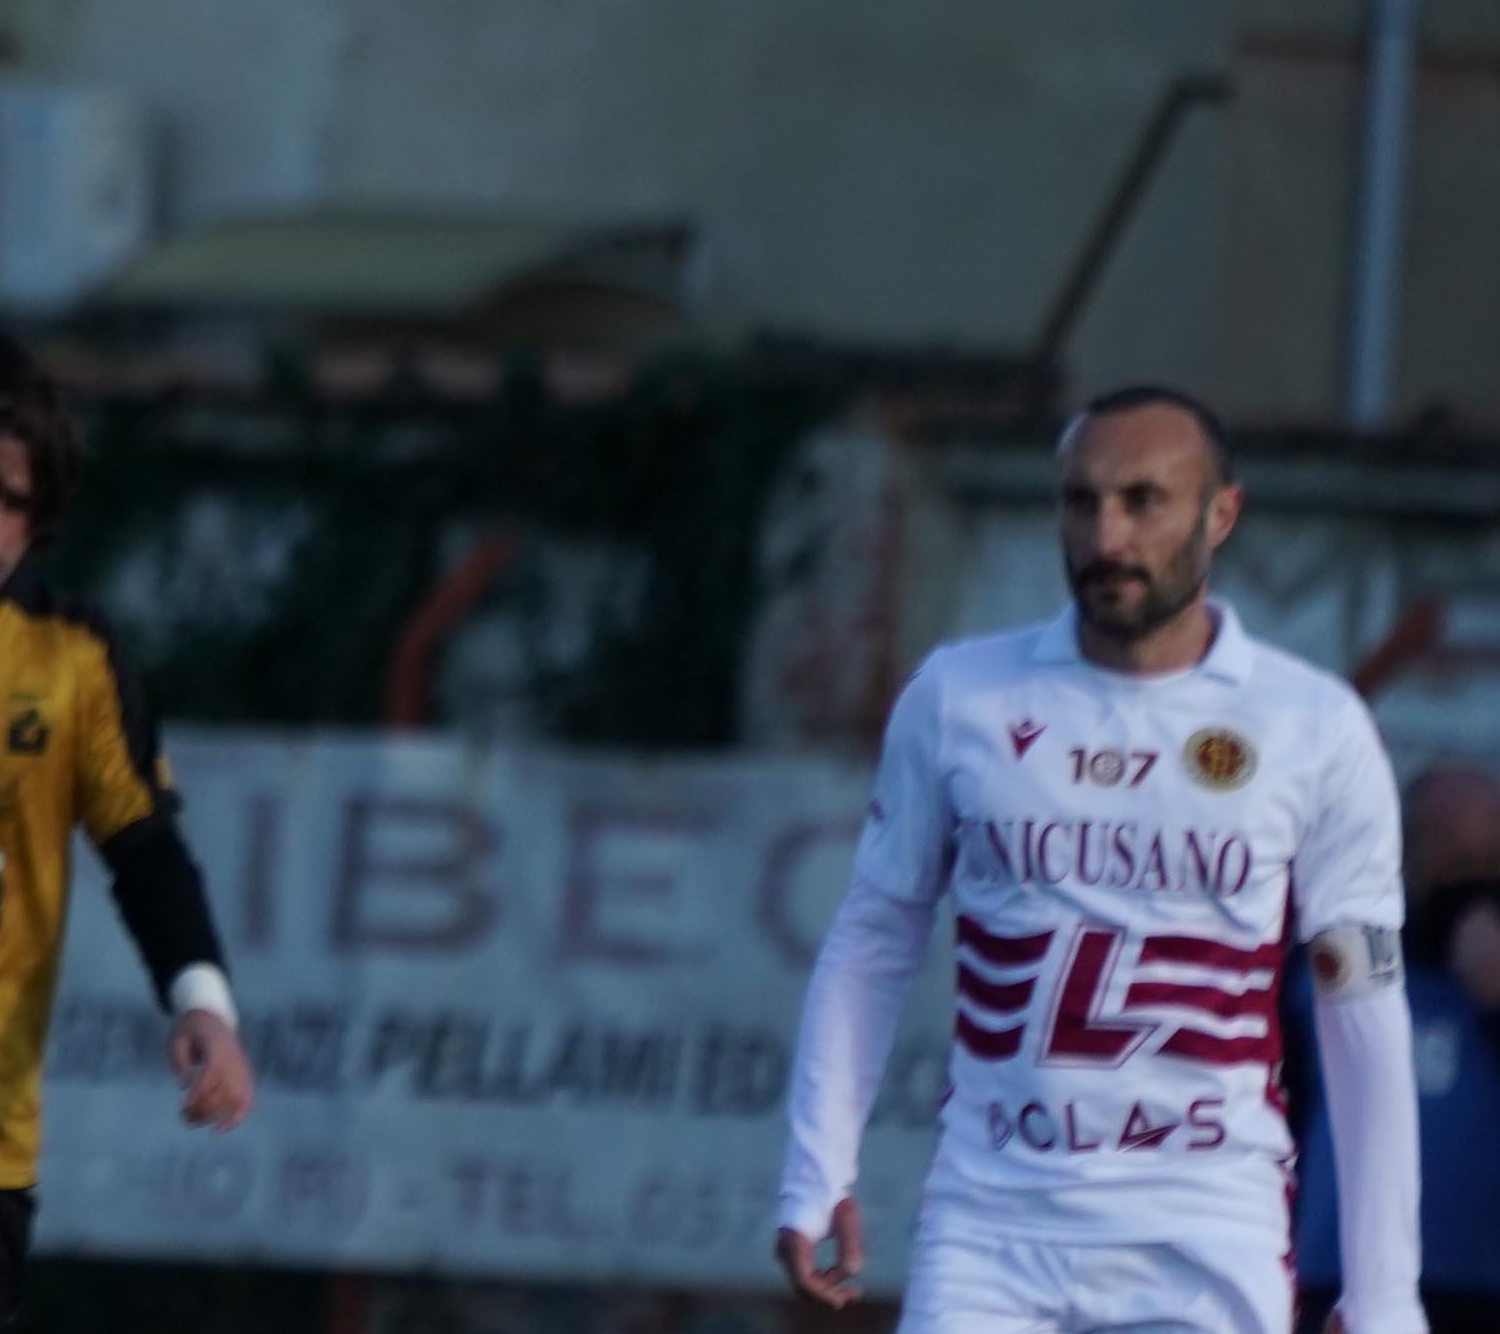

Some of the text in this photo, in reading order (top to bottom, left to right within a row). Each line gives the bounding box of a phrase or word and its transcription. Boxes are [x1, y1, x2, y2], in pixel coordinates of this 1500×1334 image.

[1067, 746, 1158, 788] 107
[368, 1000, 686, 1105] PELLAMI
[1015, 1097, 1227, 1155] CLAS
